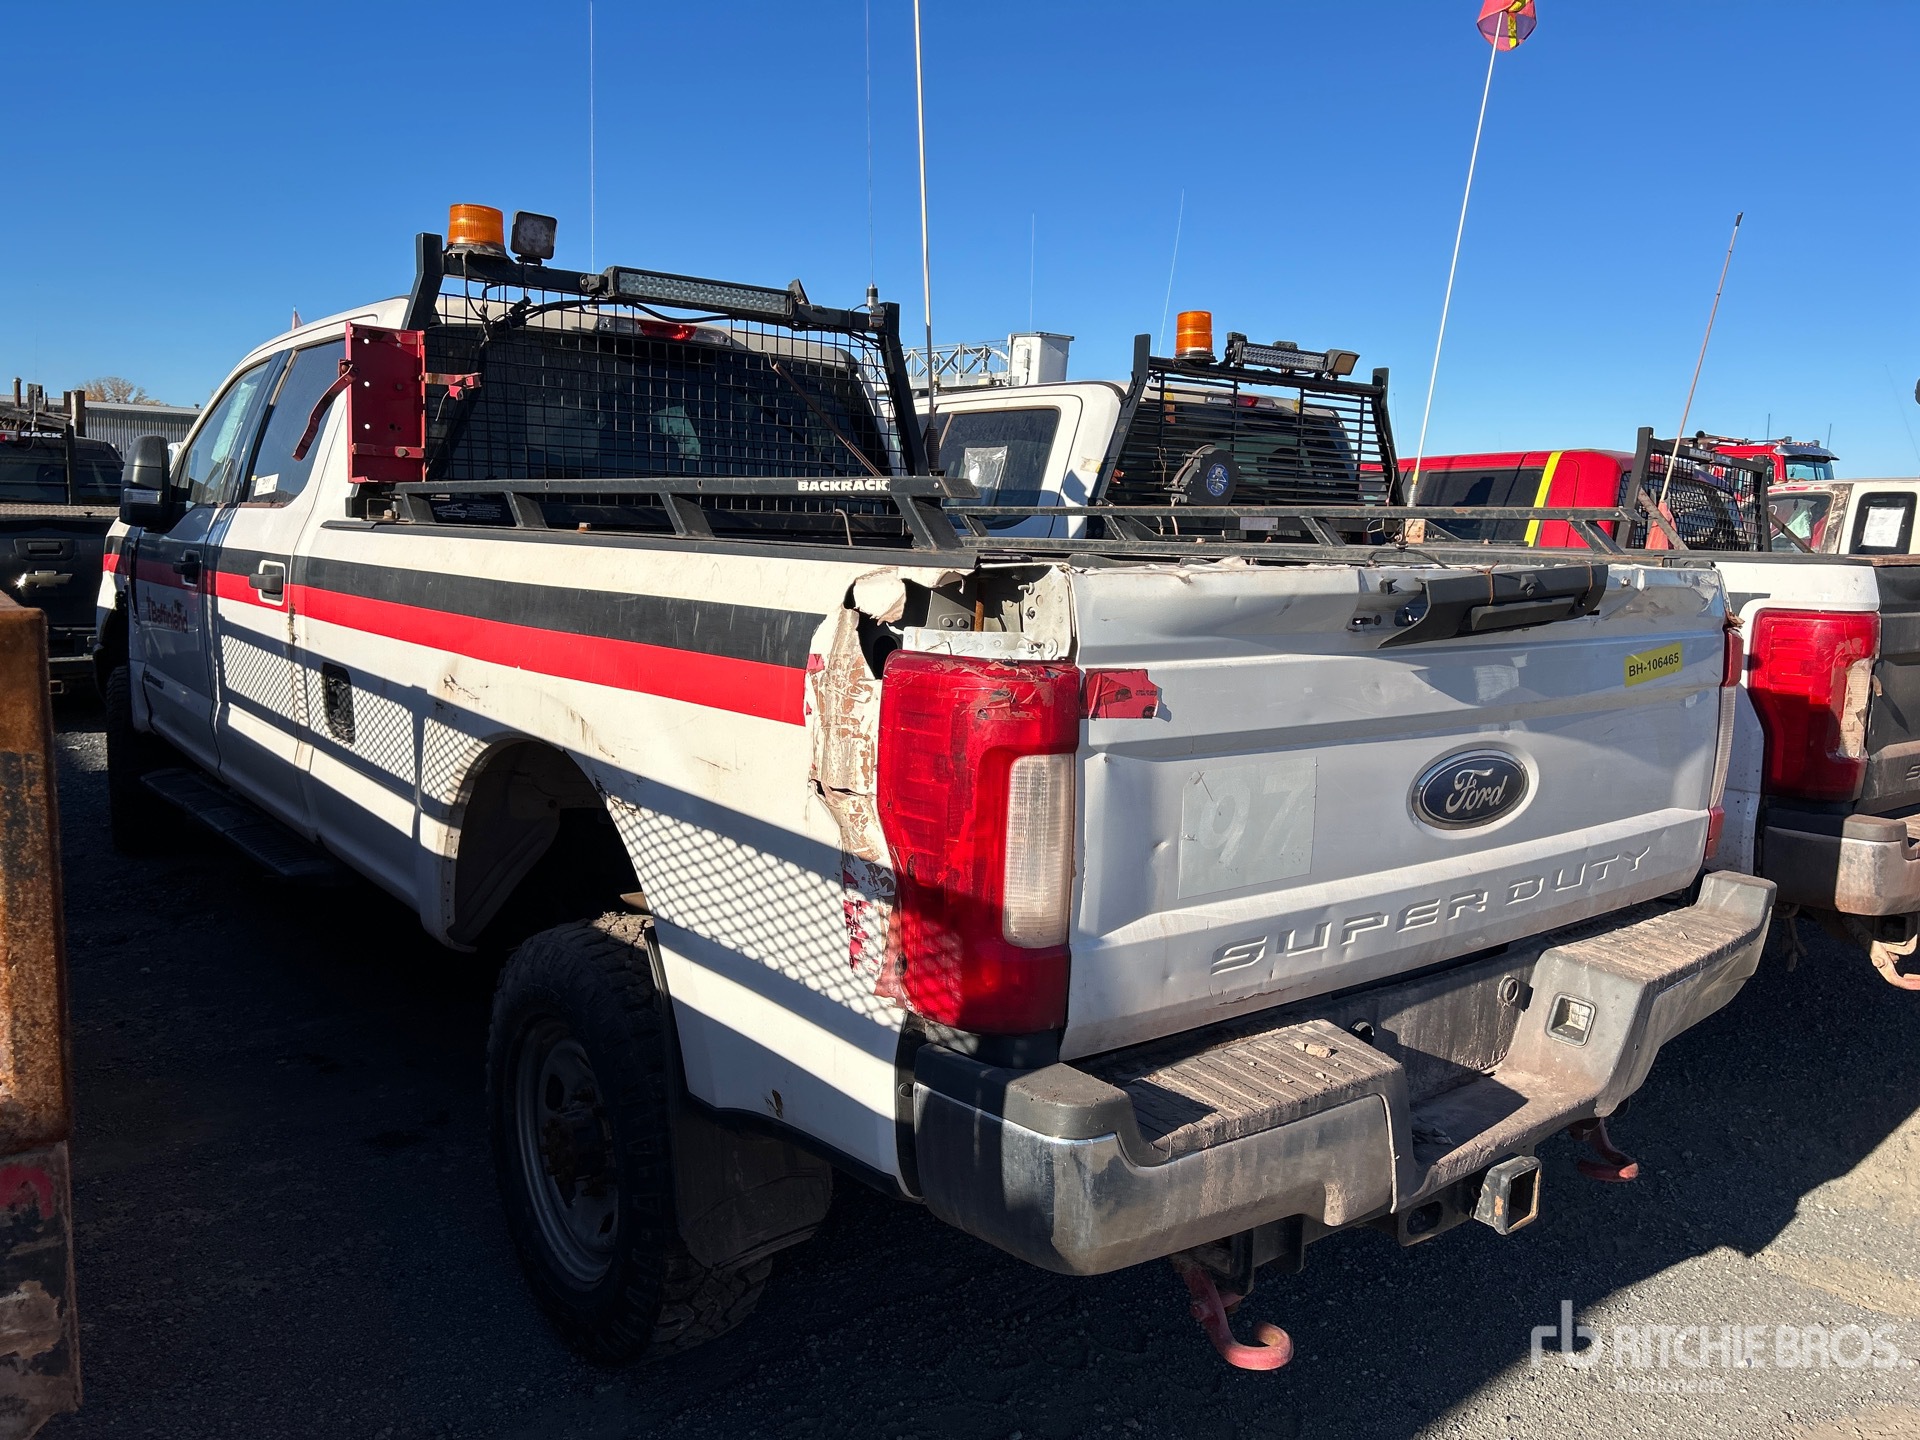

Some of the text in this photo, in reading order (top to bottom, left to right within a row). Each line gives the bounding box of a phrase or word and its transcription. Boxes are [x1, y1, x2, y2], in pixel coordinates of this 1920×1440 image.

[797, 479, 891, 491] BACKRACK
[1628, 652, 1680, 678] BH-106465
[1445, 767, 1508, 814] Ford
[1211, 846, 1650, 975] SUPER DUTY
